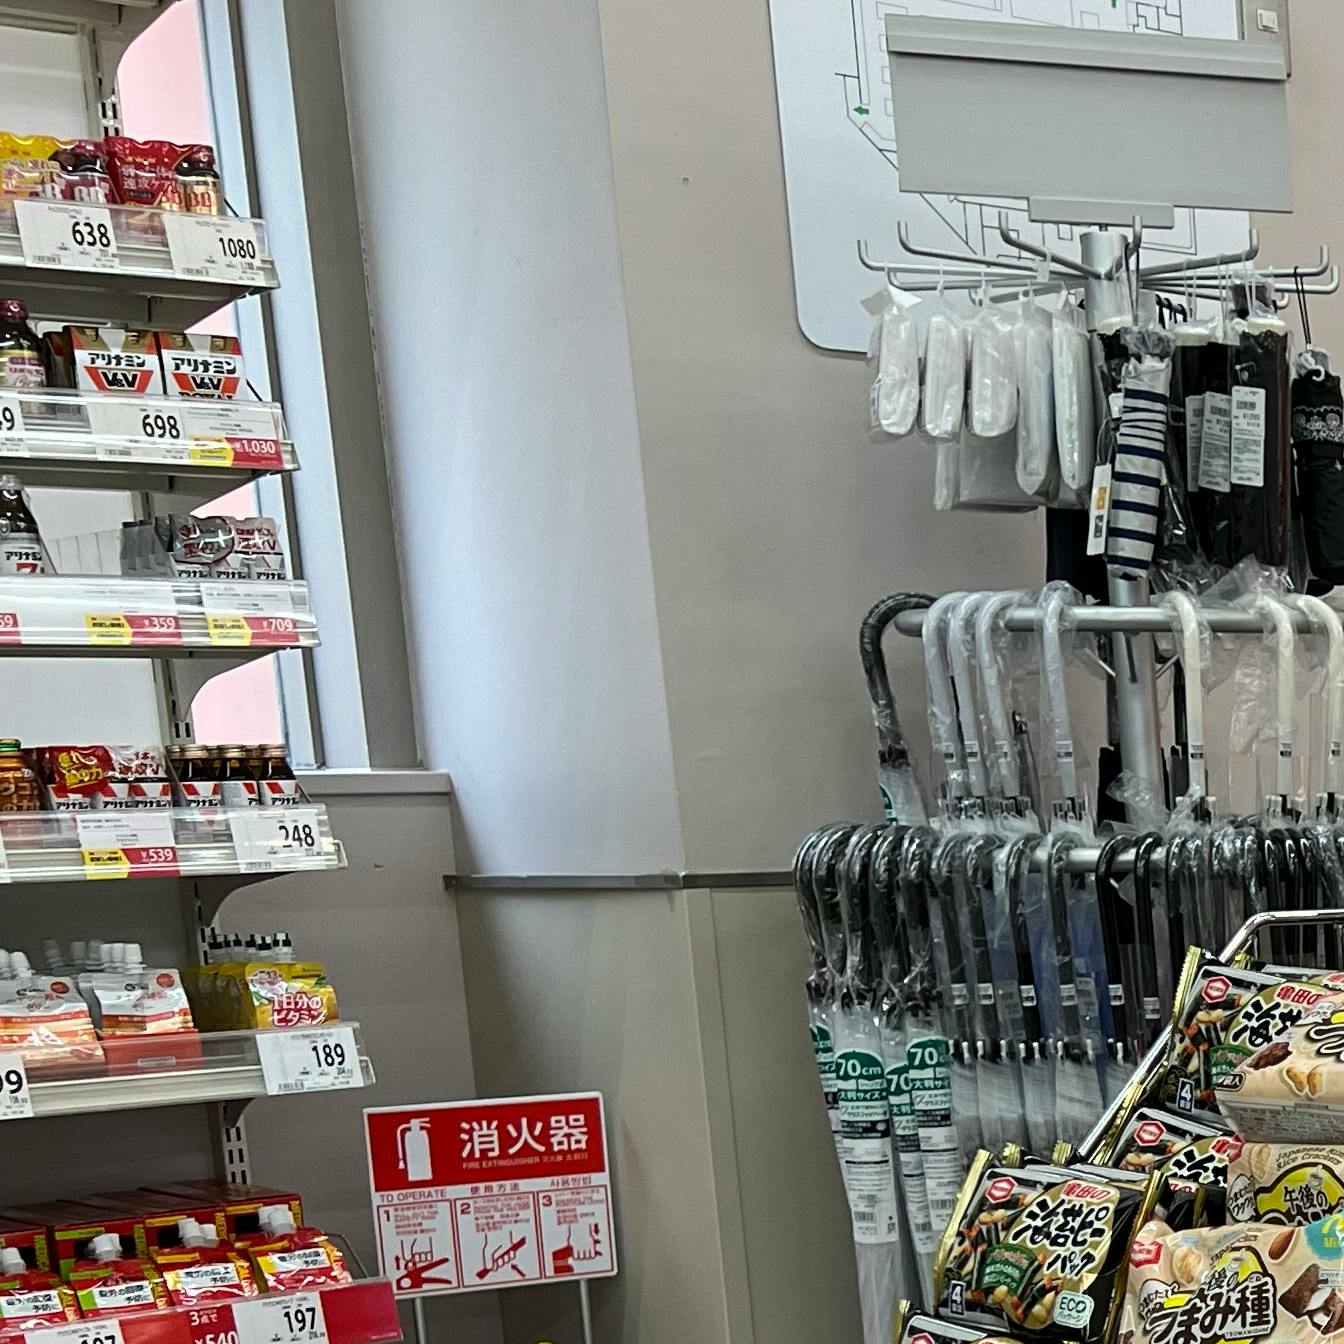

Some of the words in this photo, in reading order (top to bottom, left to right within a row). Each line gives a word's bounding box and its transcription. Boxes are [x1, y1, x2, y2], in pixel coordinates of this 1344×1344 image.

[72, 221, 111, 248] 638
[219, 236, 256, 259] 1080
[87, 352, 146, 368] アリナミン
[172, 356, 237, 375] アリナミン
[142, 414, 180, 440] 698
[279, 824, 316, 848] 248
[312, 1043, 346, 1069] 189
[838, 1057, 882, 1077] 70cm
[460, 1113, 589, 1158] 消火器
[379, 1194, 395, 1204] TO
[397, 1188, 448, 1202] OPERATE
[471, 1183, 520, 1195] 使用方法
[461, 1202, 471, 1215] 2
[542, 1194, 553, 1207] 3
[1060, 1297, 1087, 1314] ECO
[284, 1307, 317, 1335] 197
